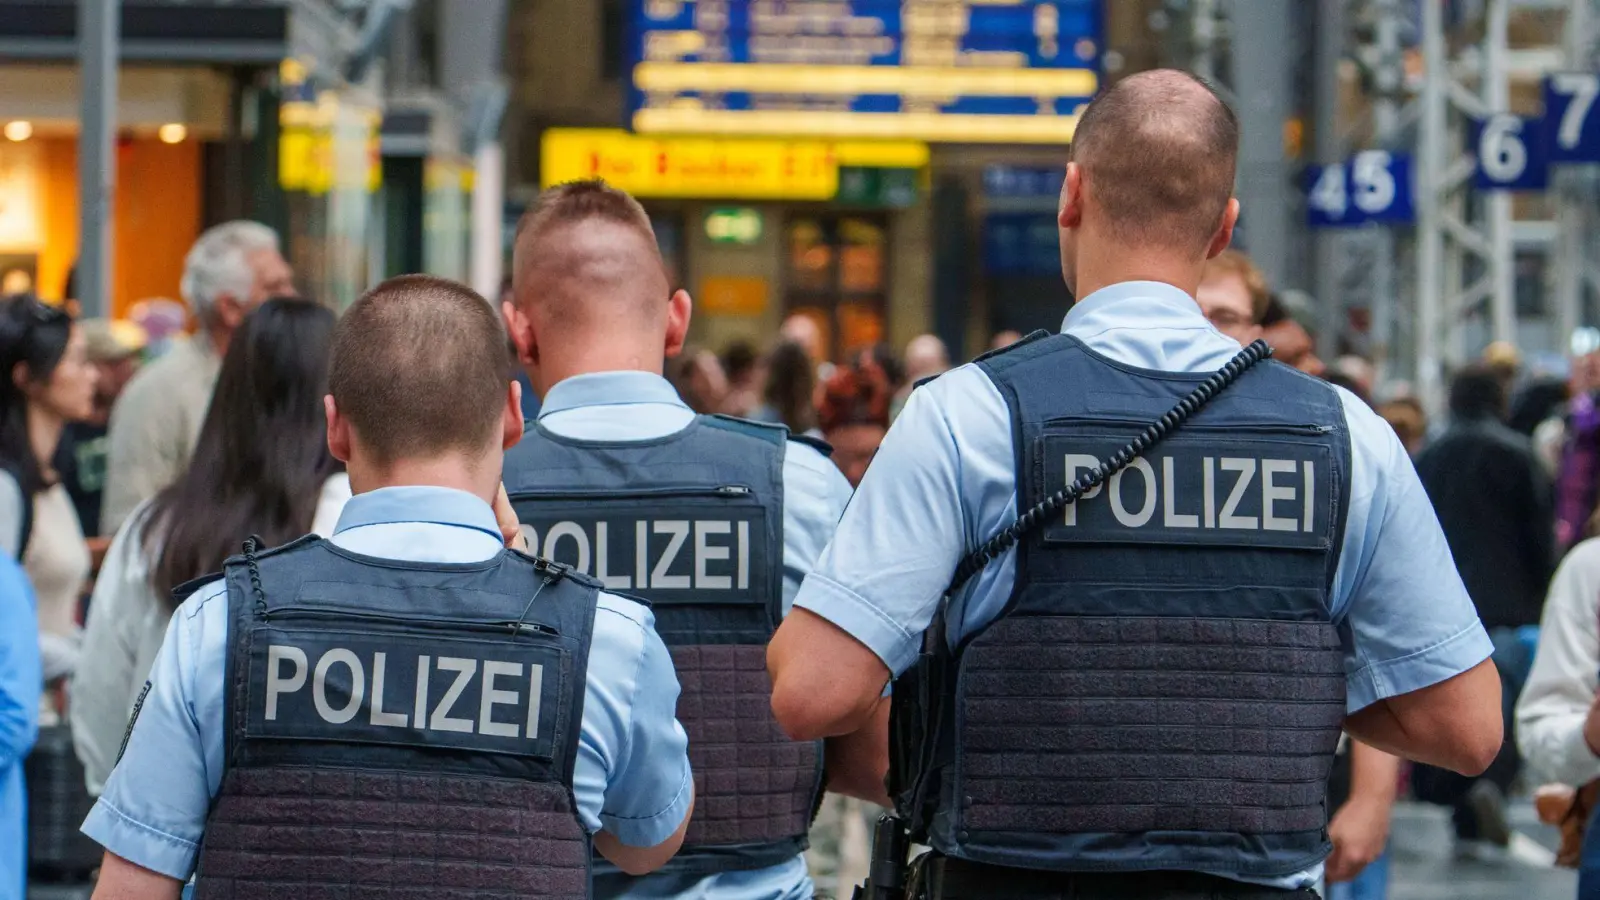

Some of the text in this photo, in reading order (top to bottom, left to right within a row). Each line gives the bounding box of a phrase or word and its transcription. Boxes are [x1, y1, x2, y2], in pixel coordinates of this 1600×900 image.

[1552, 75, 1597, 148] 7
[1353, 150, 1396, 213] 5
[1480, 114, 1527, 182] 6
[1310, 163, 1347, 218] 4
[1065, 453, 1314, 532] POLIZEI
[264, 644, 543, 738] POLIZEI
